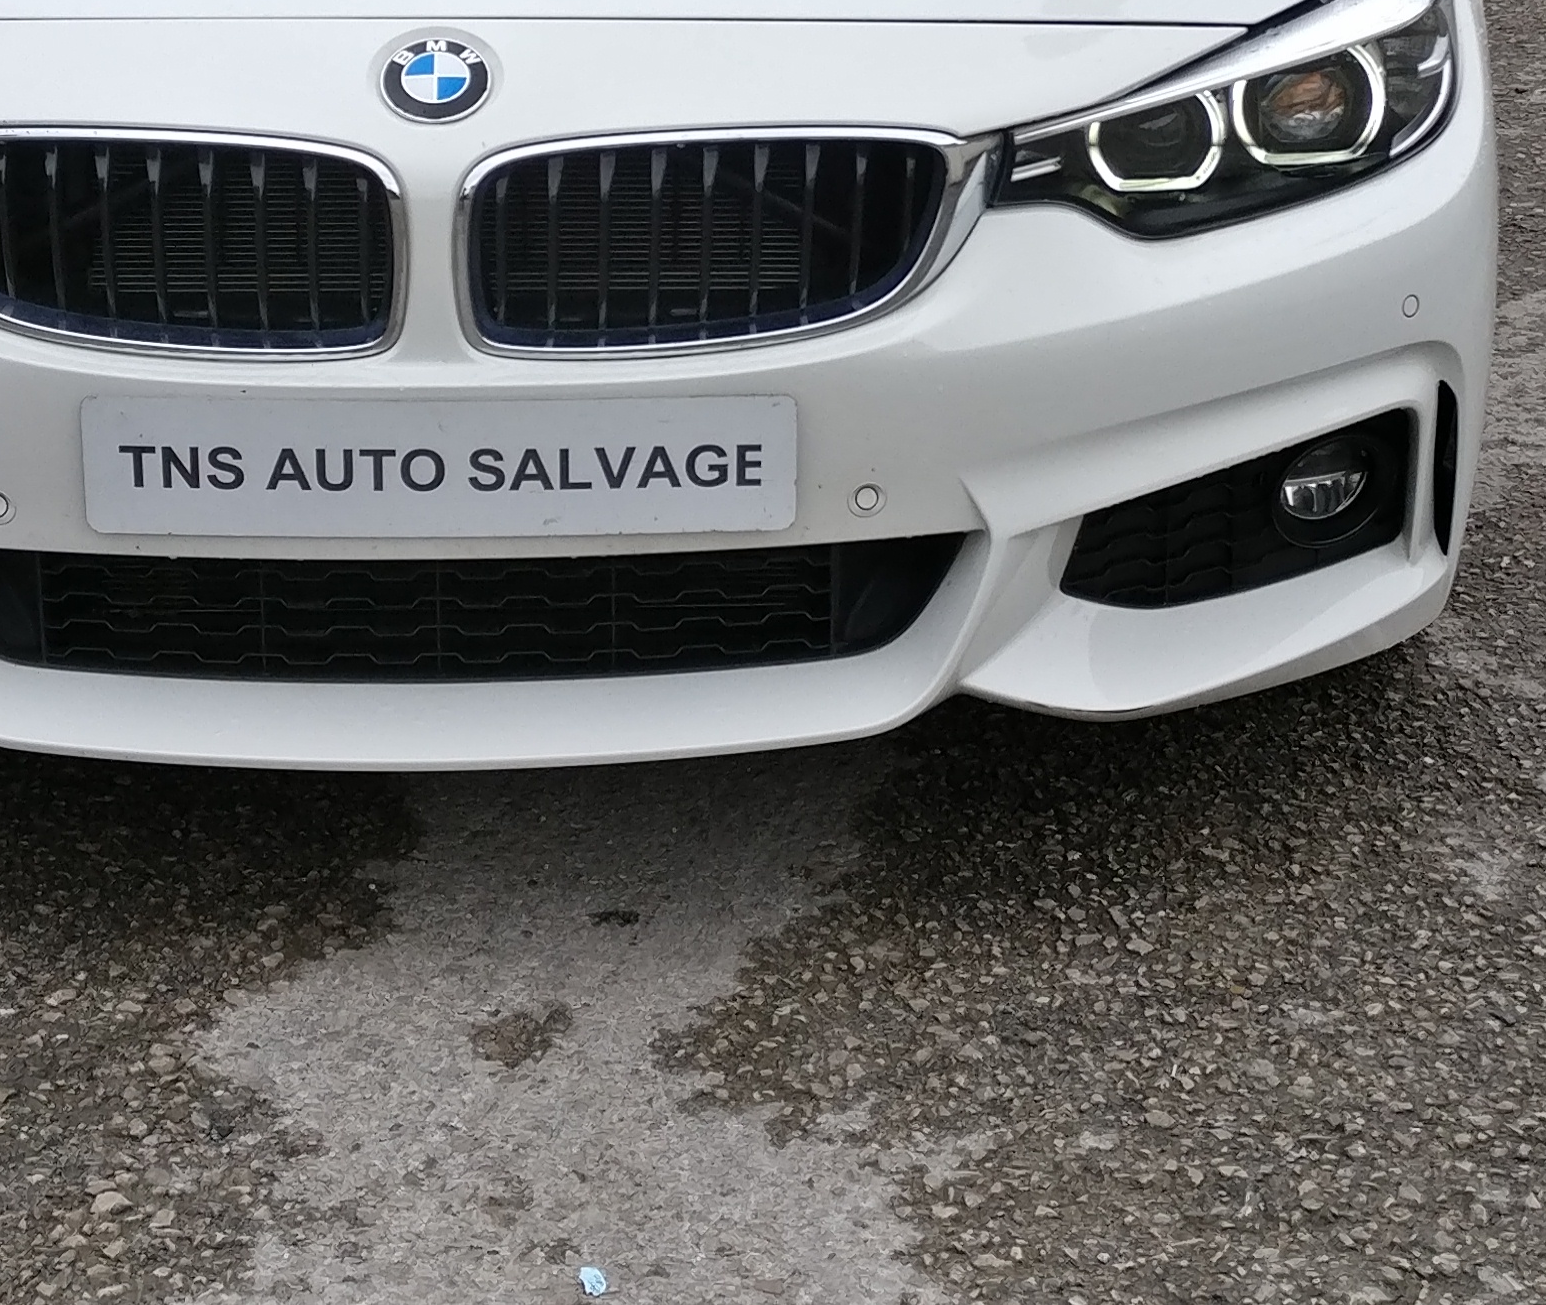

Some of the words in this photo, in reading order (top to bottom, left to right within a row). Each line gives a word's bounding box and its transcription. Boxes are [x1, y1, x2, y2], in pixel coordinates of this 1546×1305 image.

[392, 40, 482, 66] BMW
[118, 444, 245, 490] TNS
[265, 446, 447, 493] AUTO
[466, 442, 763, 494] SALVAGE
